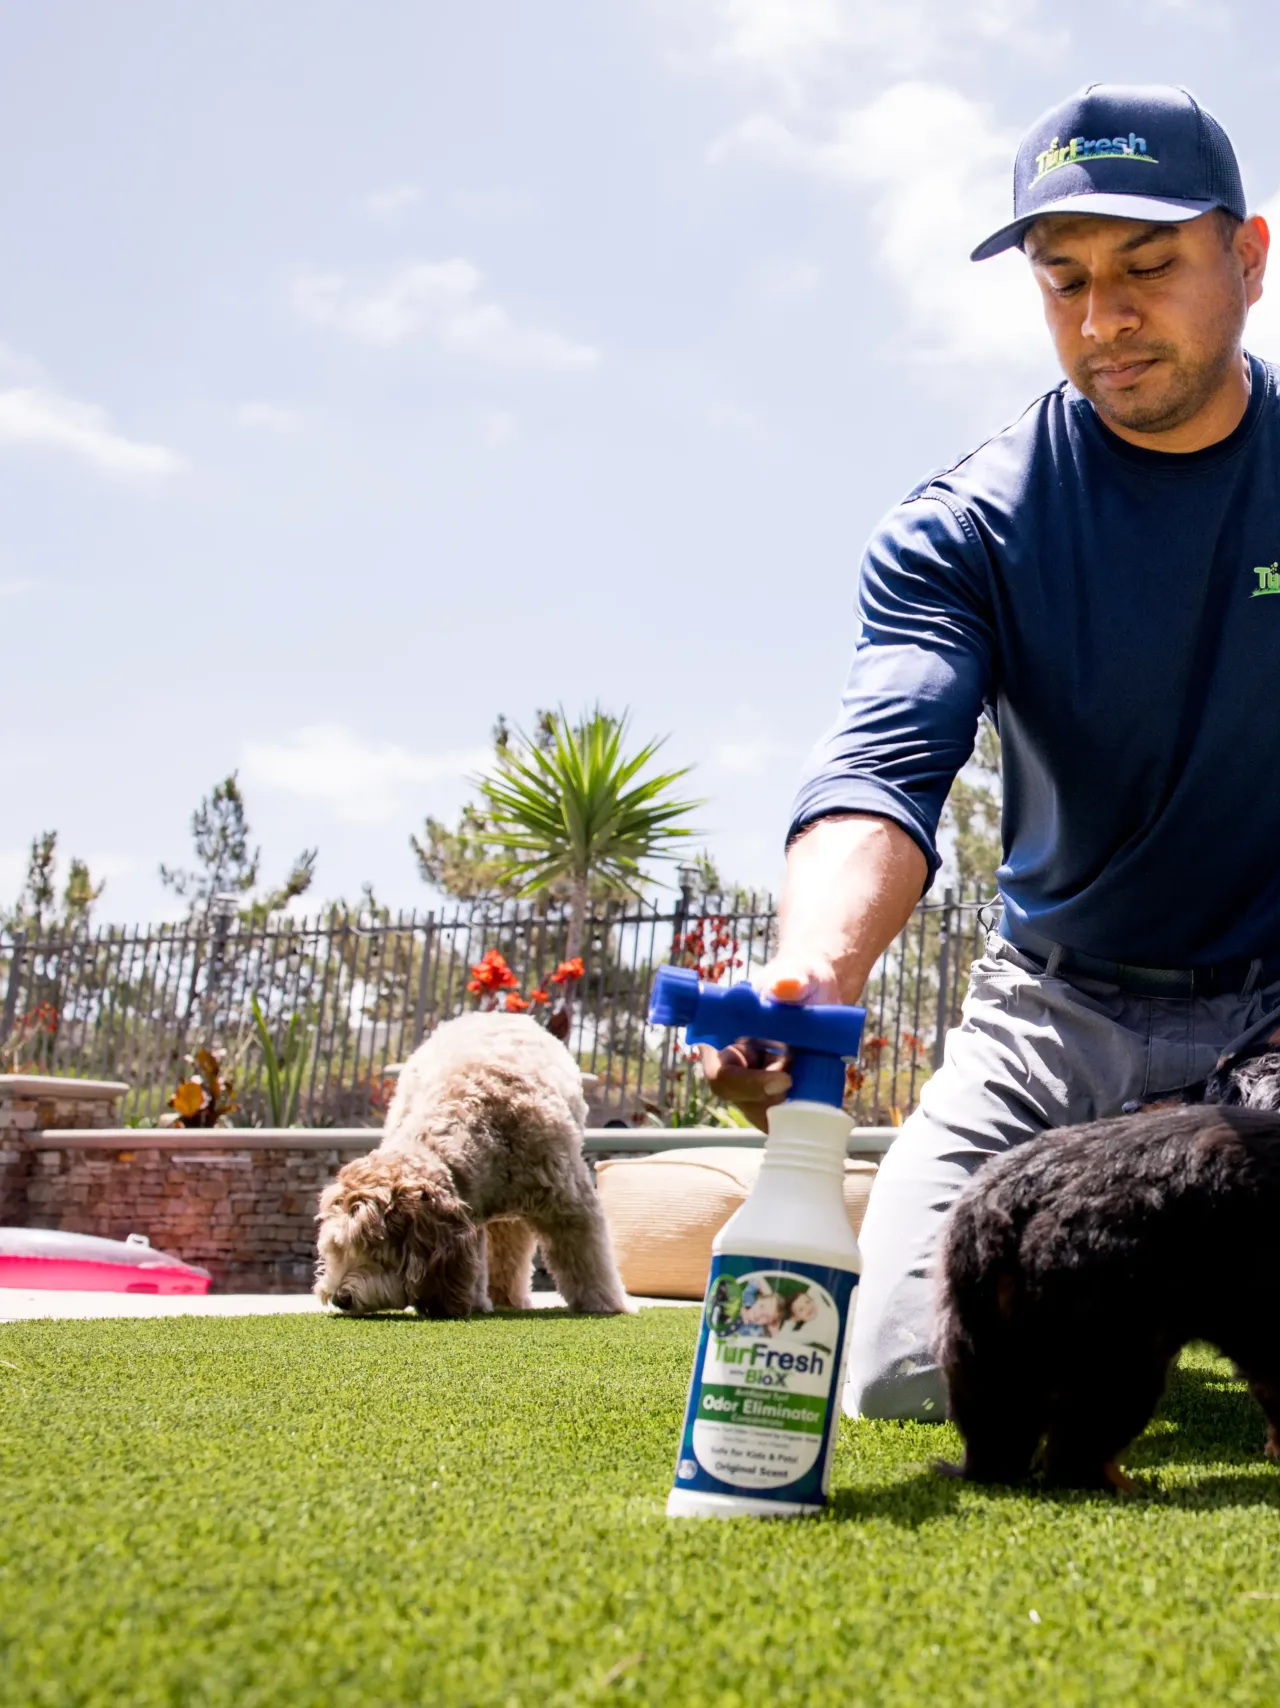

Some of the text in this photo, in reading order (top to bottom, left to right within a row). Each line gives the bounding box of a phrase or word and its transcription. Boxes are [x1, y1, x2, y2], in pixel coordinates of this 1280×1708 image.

[1036, 132, 1147, 175] TurFresh
[715, 1337, 824, 1376] TurFresh
[745, 1369, 788, 1388] BioX
[702, 1394, 740, 1413] Odor
[742, 1398, 821, 1423] Eliminator
[746, 1449, 766, 1460] Kids
[715, 1461, 788, 1478] Original Scent
